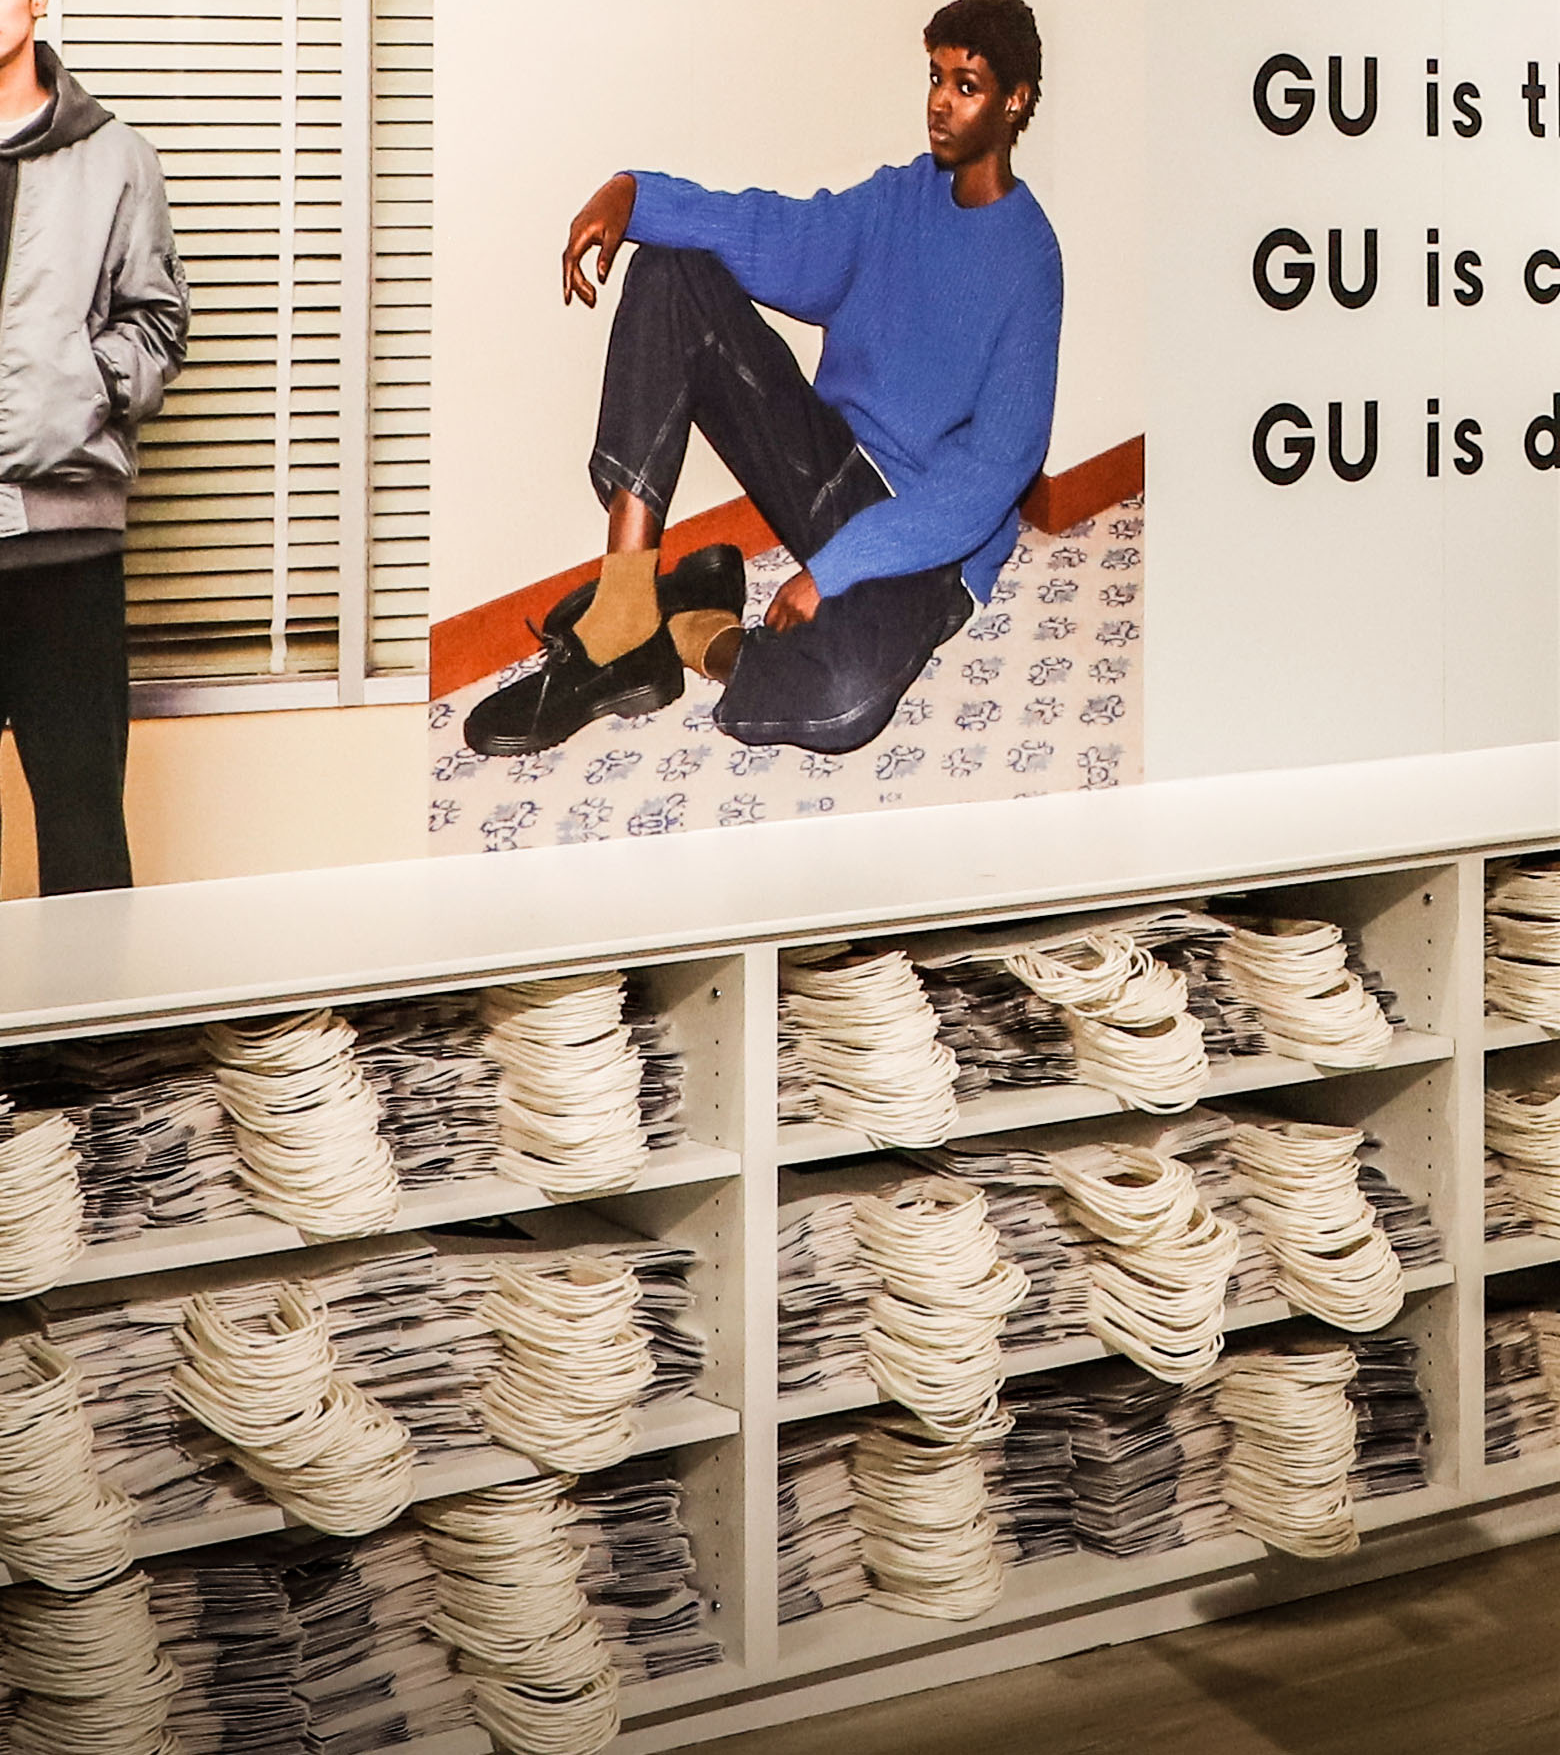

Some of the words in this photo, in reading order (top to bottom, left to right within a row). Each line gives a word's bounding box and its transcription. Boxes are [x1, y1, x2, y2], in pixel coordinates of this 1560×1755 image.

[1252, 52, 1378, 137] GU
[1426, 58, 1483, 139] is
[1521, 61, 1560, 139] t
[1252, 227, 1378, 312] GU
[1426, 227, 1484, 308] is
[1252, 400, 1379, 486] GU
[1426, 397, 1484, 478] is
